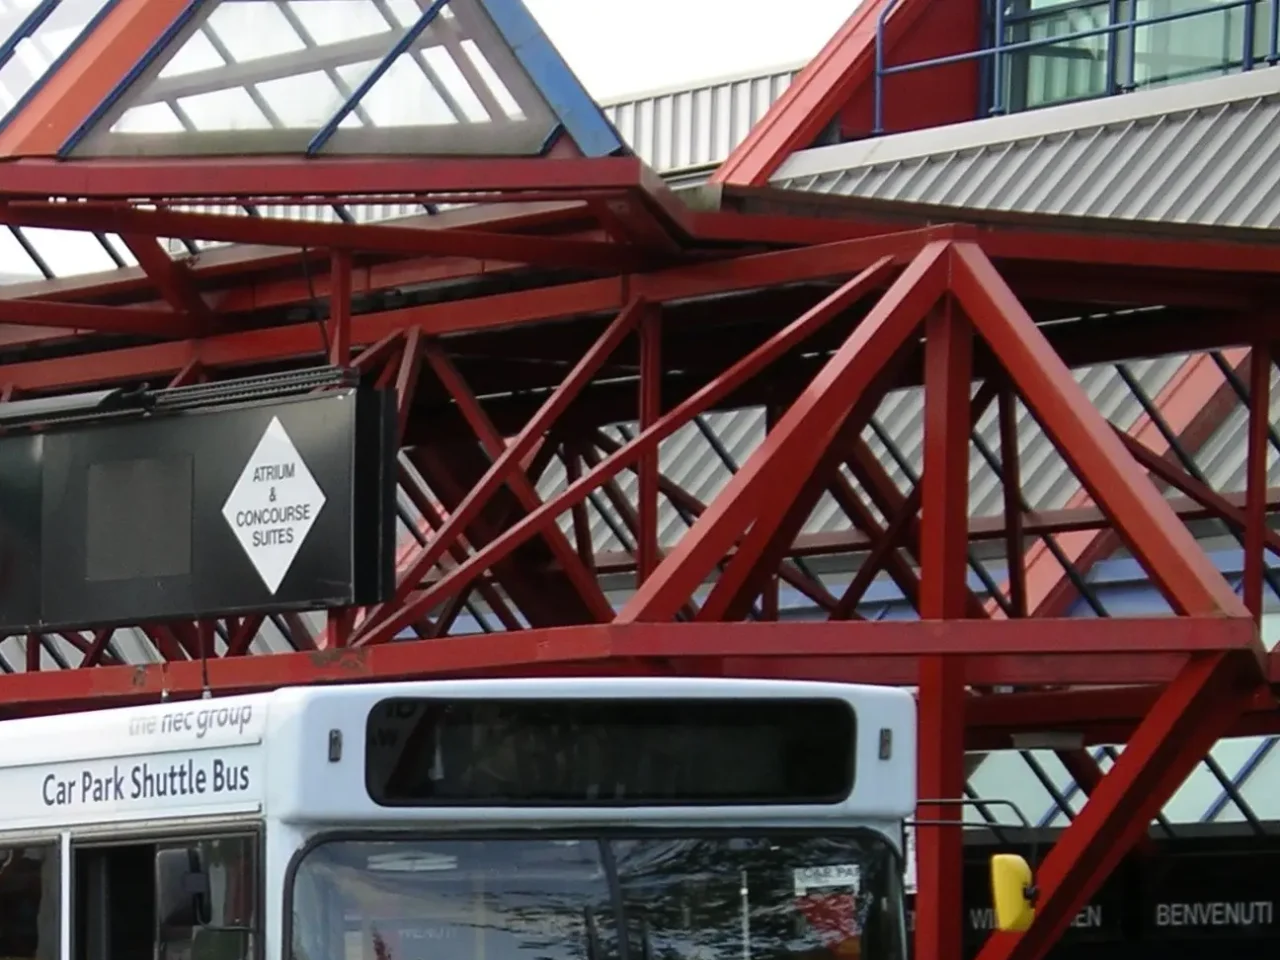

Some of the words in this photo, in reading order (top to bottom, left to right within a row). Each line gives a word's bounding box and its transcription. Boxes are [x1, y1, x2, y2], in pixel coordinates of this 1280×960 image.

[253, 462, 296, 483] ATRIUM
[269, 486, 277, 502] &
[236, 504, 310, 528] CONCOURSE
[252, 527, 294, 547] SUITES
[161, 710, 195, 733] nec
[196, 704, 252, 739] group
[42, 773, 76, 806] Car
[81, 765, 124, 803] Park
[131, 758, 207, 799] Shuttle
[213, 759, 250, 792] Bus
[1155, 901, 1273, 927] BENVENUTI
